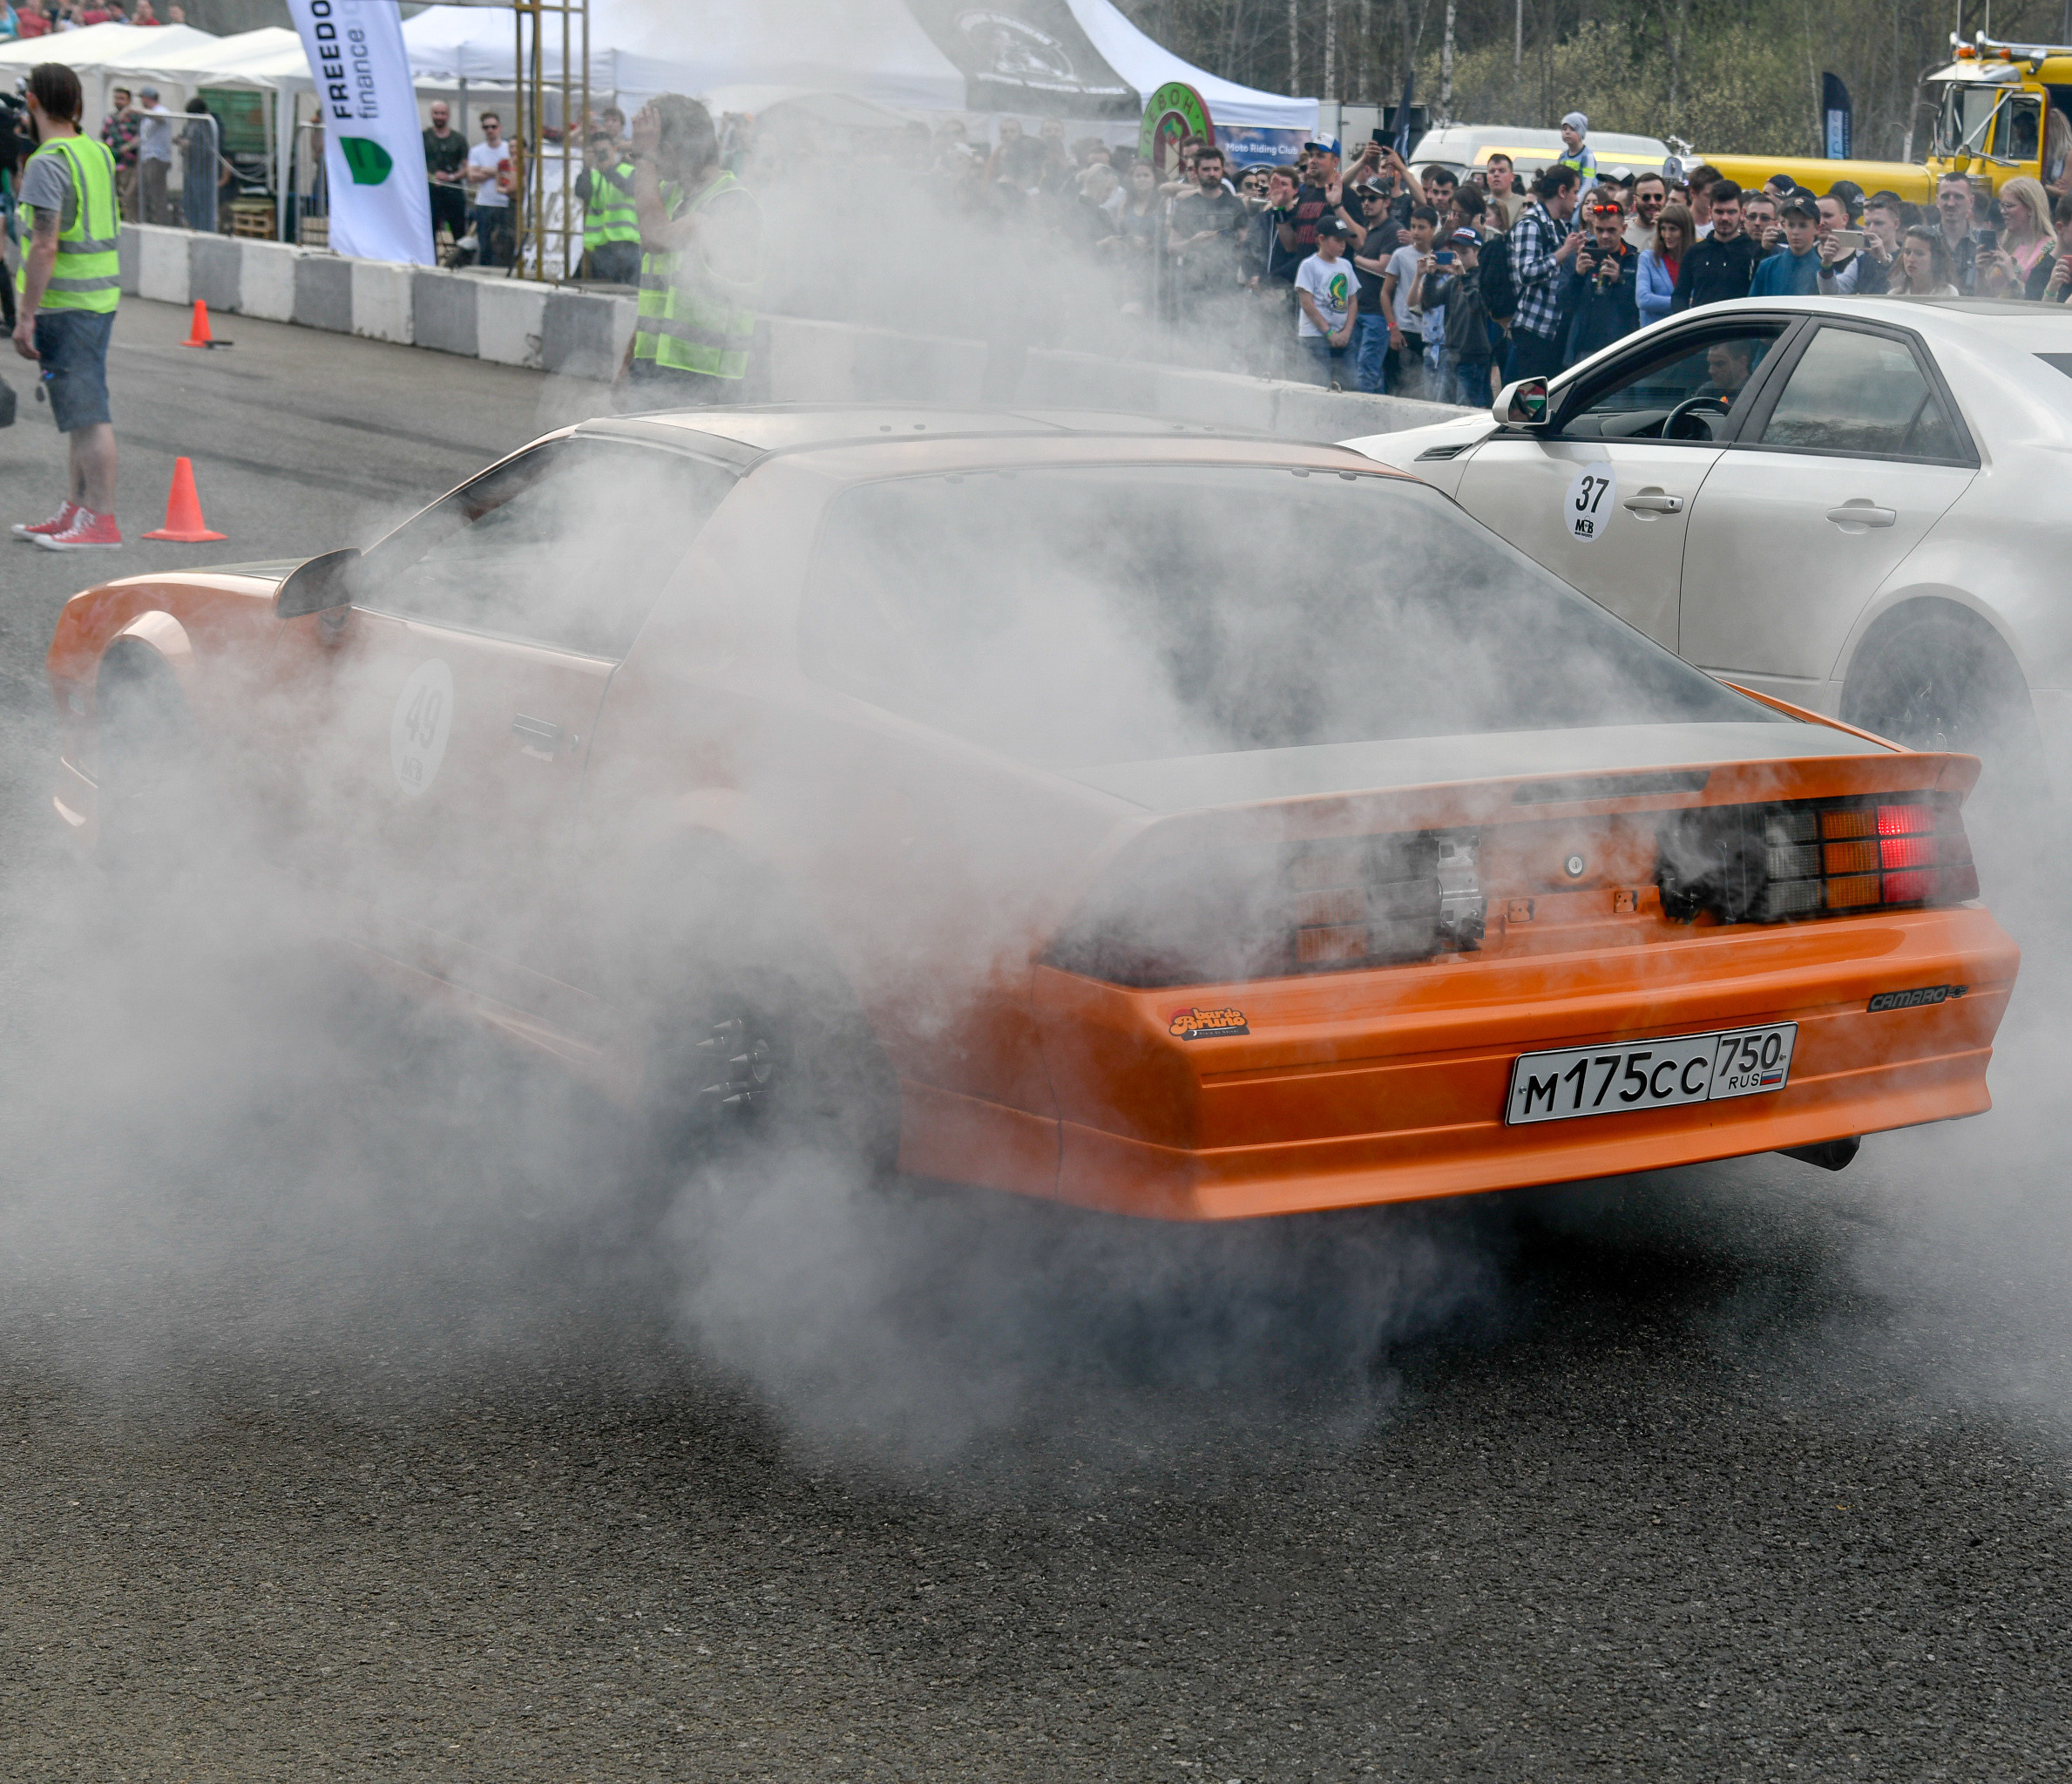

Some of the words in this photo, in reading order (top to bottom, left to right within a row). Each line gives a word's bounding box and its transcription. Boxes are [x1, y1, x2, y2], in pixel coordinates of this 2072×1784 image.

[348, 28, 379, 120] finance
[1225, 143, 1249, 153] Moto
[1250, 143, 1277, 155] Riding
[1278, 145, 1299, 155] Club
[1575, 475, 1609, 513] 37
[404, 684, 443, 750] 49
[1871, 987, 1947, 1010] CAMARO
[1170, 1015, 1246, 1034] Bruno
[1718, 1032, 1783, 1077] 750
[1728, 1073, 1760, 1090] RUS
